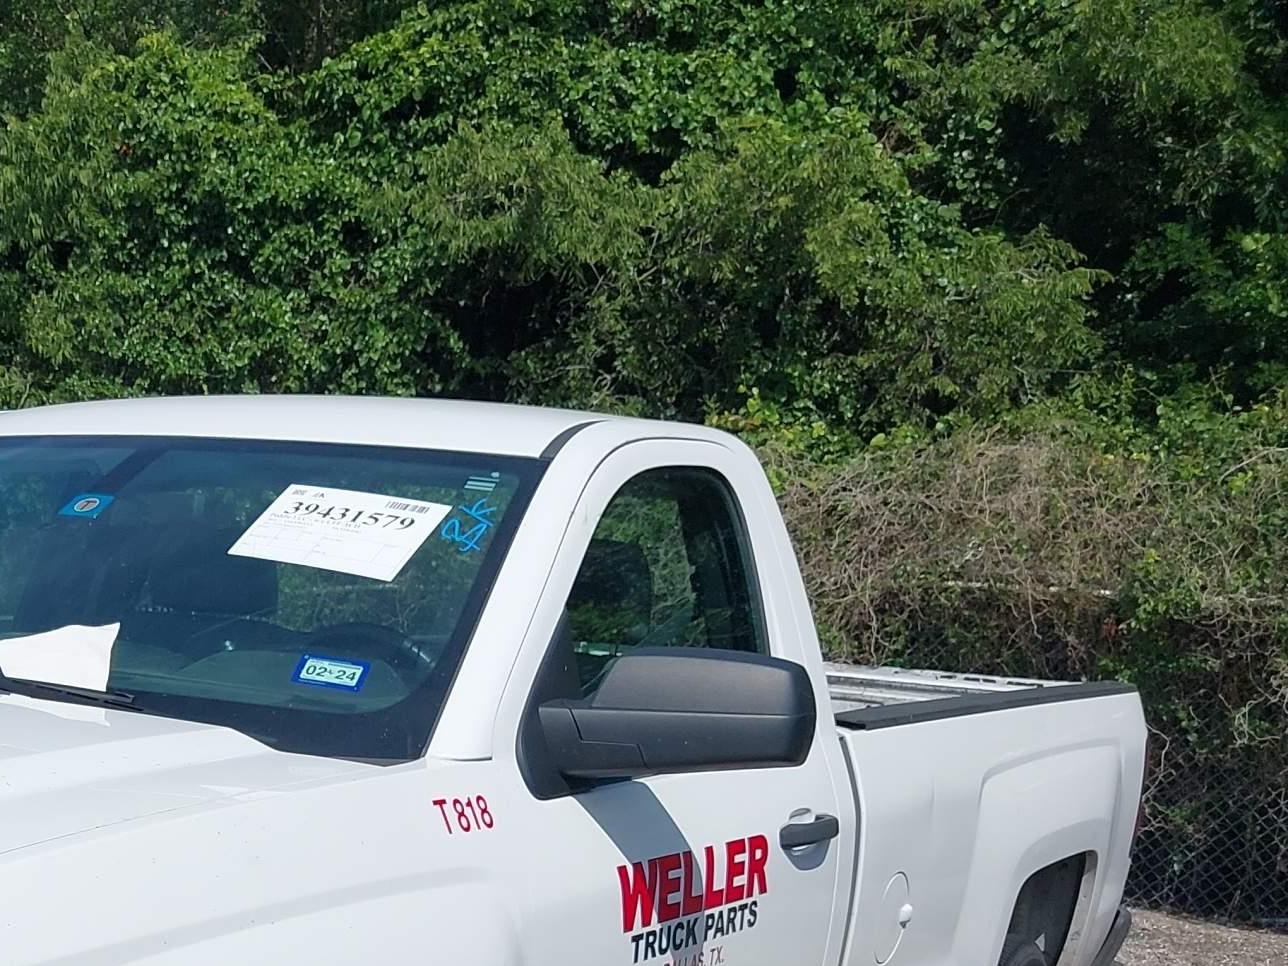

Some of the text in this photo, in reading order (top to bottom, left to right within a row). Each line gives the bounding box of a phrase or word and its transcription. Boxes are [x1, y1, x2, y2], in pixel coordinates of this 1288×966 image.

[284, 501, 416, 531] 39431579
[305, 665, 357, 681] 02 24
[616, 834, 769, 934] WELLER
[631, 900, 759, 964] TRUCK PARTS
